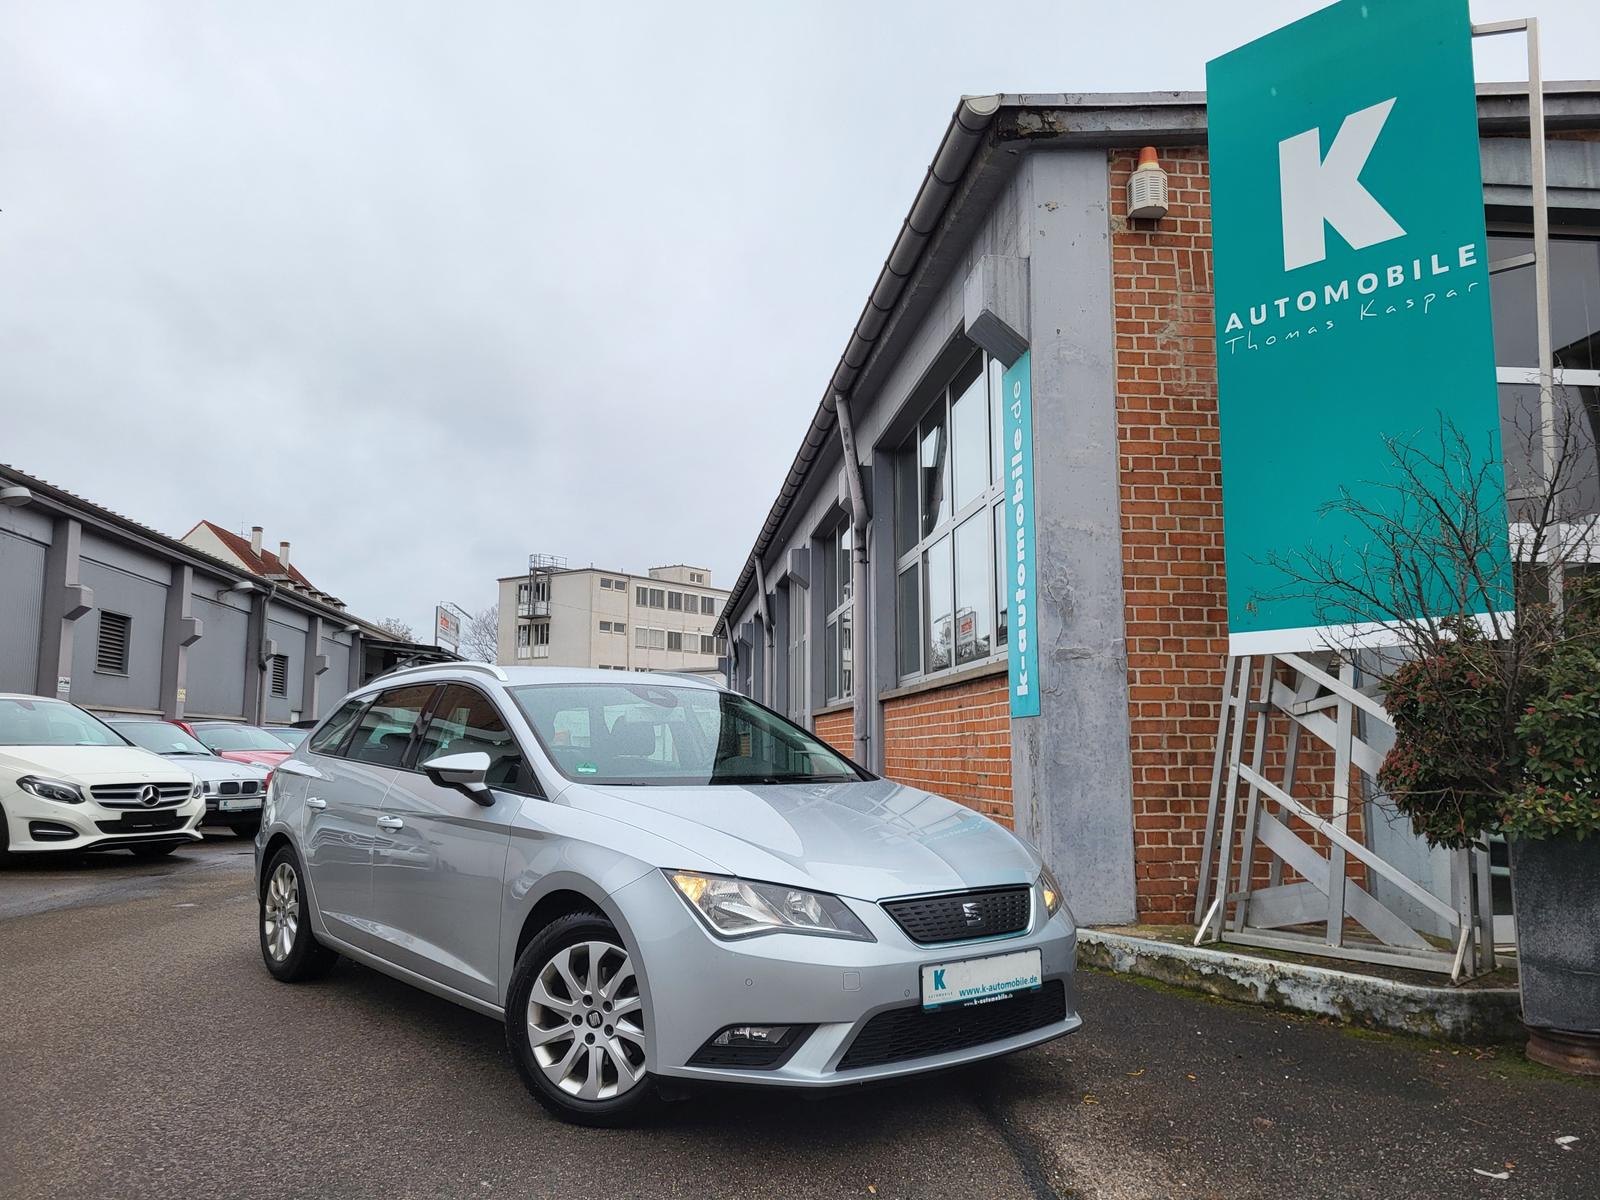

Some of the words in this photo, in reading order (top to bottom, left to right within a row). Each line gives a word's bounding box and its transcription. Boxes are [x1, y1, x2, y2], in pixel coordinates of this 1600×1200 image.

[1279, 97, 1407, 272] K
[1224, 243, 1478, 333] AUTOMOBILE
[1225, 319, 1335, 355] Thomas
[1360, 282, 1479, 321] Kaspar
[1011, 380, 1029, 697] k-automobile.de
[934, 969, 946, 991] K
[959, 975, 1038, 997] www.k-automobile.de
